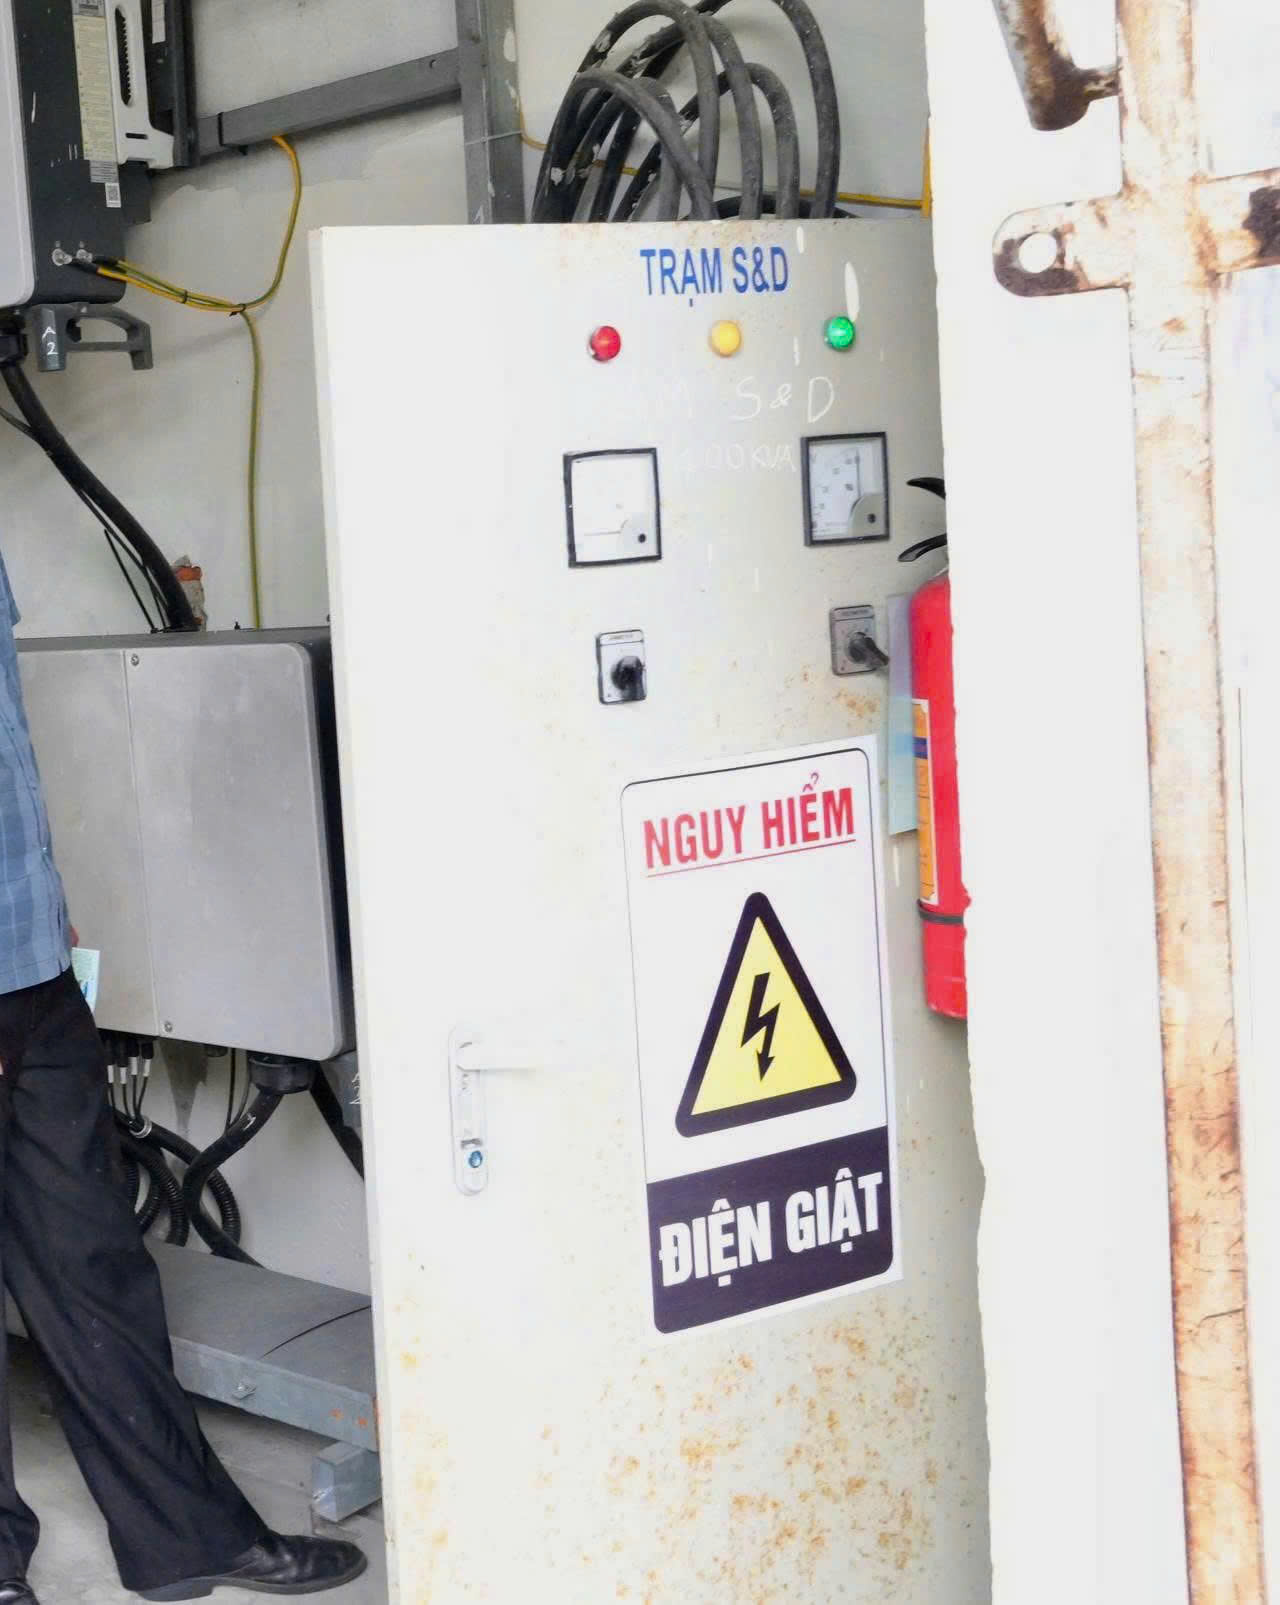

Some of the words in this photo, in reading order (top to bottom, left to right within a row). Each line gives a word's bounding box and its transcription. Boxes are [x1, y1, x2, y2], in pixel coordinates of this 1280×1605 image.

[640, 247, 723, 307] TRẠM
[732, 246, 789, 293] S&D
[643, 805, 746, 870] NGUY
[761, 772, 855, 849] HIỂM
[659, 1198, 773, 1288] ĐIỆN
[785, 1167, 883, 1254] GIẬT
